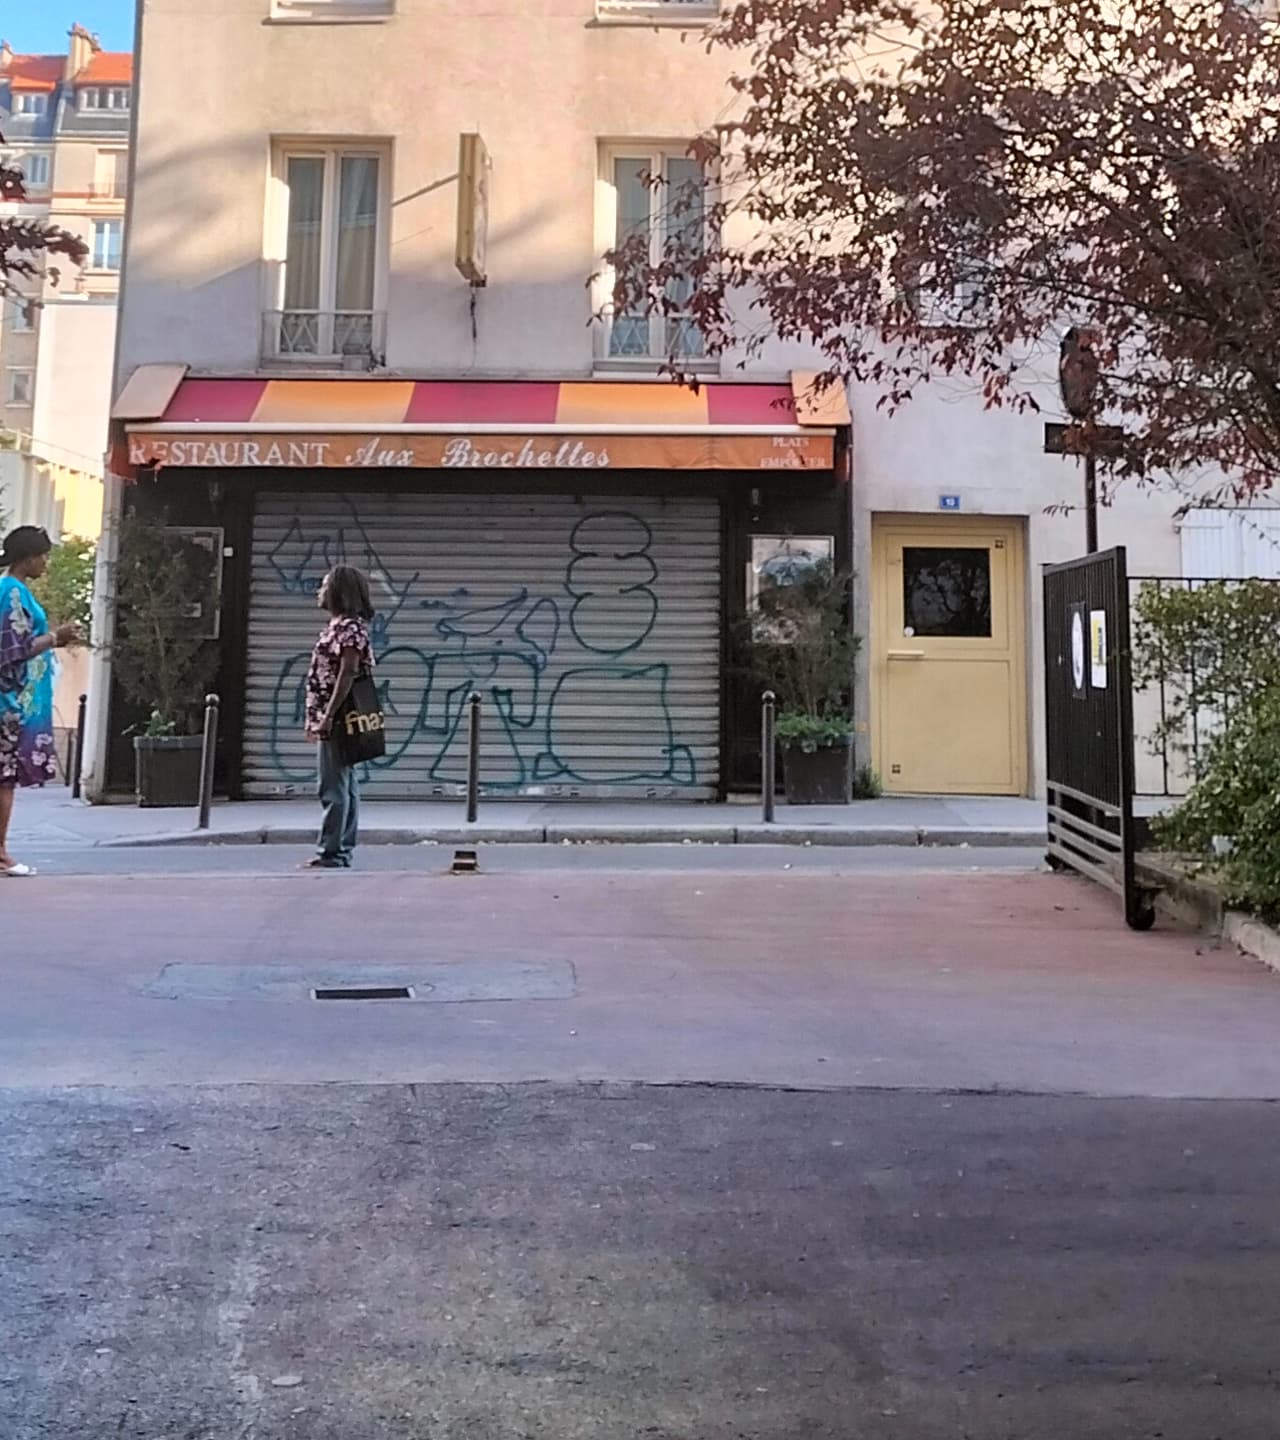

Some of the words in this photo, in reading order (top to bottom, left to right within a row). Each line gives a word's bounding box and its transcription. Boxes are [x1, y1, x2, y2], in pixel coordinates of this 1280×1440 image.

[129, 441, 331, 467] RESTAURANT
[345, 437, 414, 466] Aux
[441, 438, 610, 467] Brochettes
